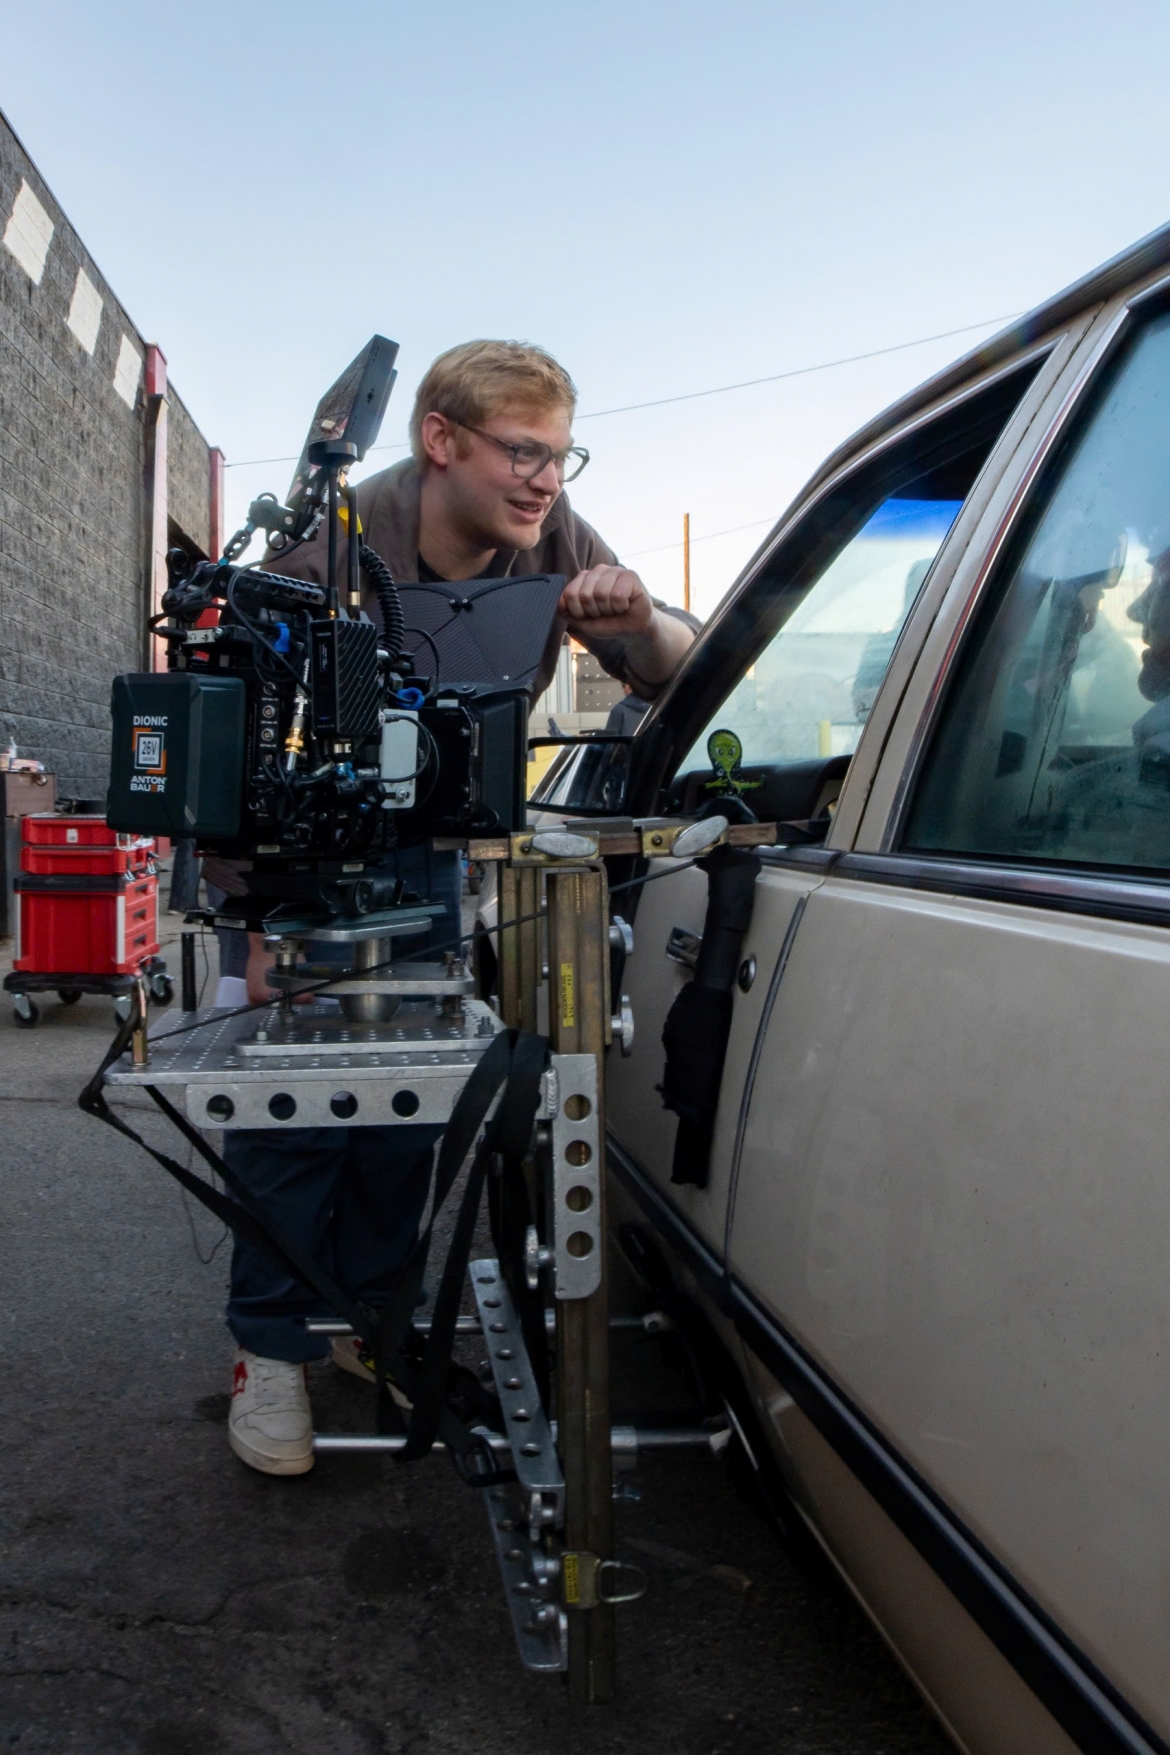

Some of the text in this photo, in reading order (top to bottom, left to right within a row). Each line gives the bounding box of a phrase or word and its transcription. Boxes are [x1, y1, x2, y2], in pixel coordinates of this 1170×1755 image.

[133, 715, 168, 726] DIONIC
[142, 741, 157, 755] 26V
[131, 775, 166, 785] ANTON
[130, 783, 165, 792] BAUER
